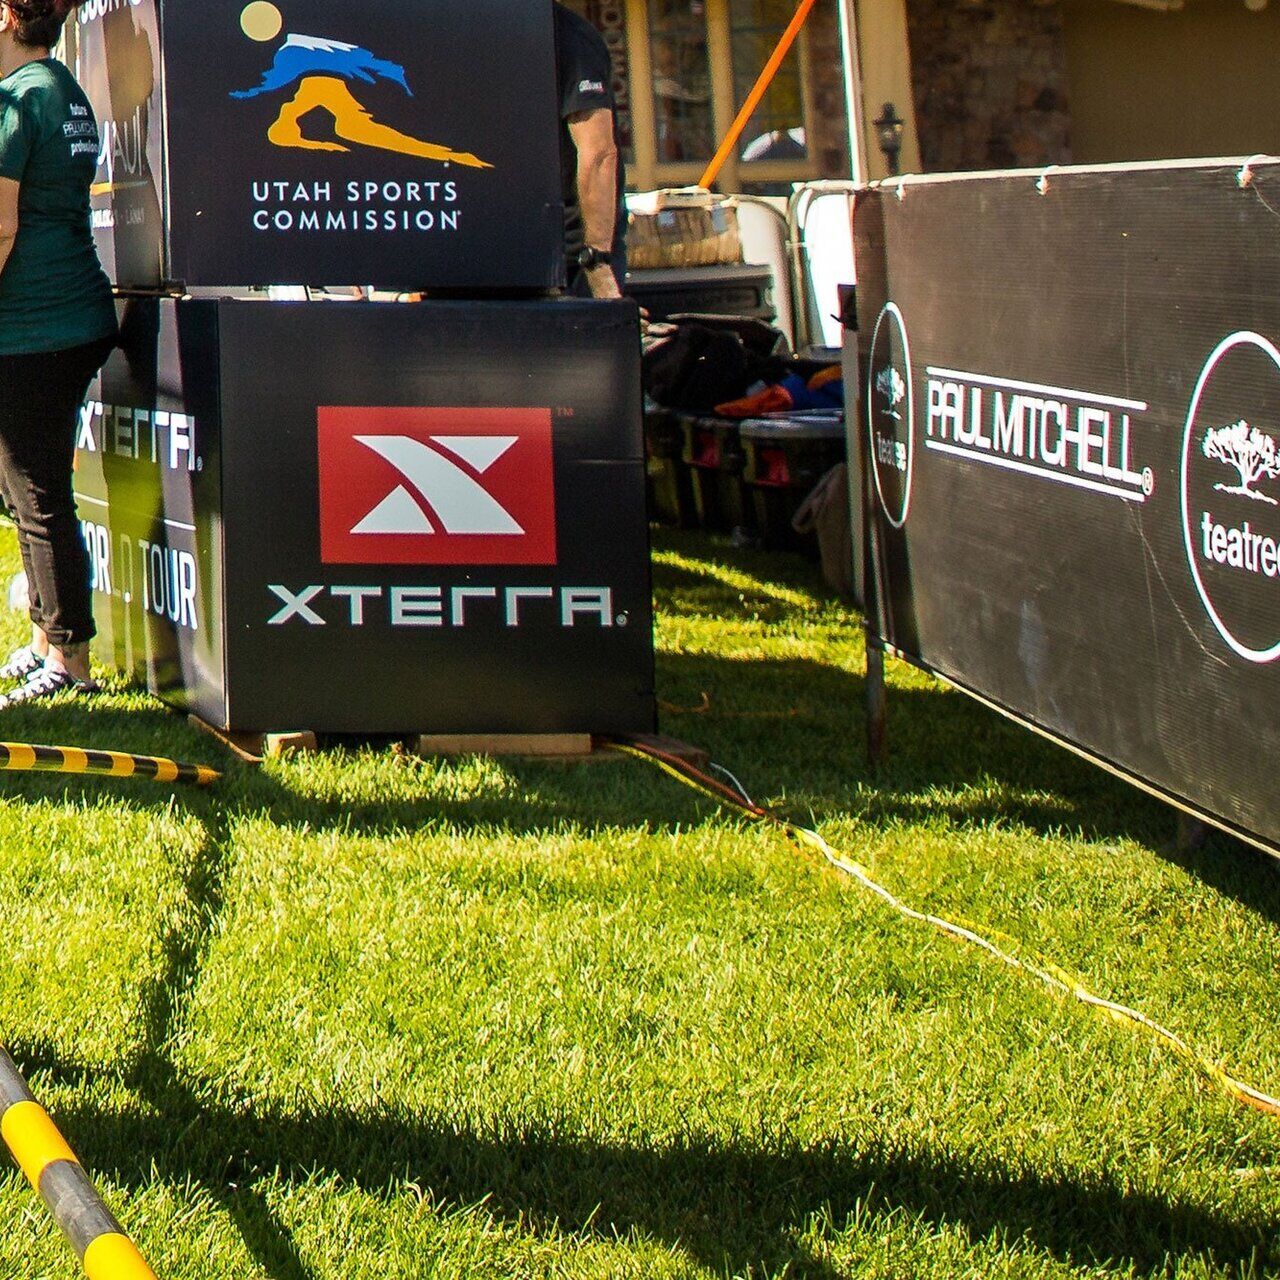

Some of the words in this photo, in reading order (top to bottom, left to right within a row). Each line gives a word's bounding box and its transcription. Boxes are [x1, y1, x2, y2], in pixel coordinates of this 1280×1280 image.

[253, 181, 331, 202] UTAH
[347, 181, 459, 202] SPORTS
[253, 209, 458, 231] COMMISSION
[927, 380, 991, 449] PAUL
[993, 392, 1143, 485] MITCHELL
[1200, 511, 1280, 578] teatre
[82, 520, 134, 604] ORLD
[138, 538, 198, 631] TOUR
[267, 584, 613, 627] XTERRA
